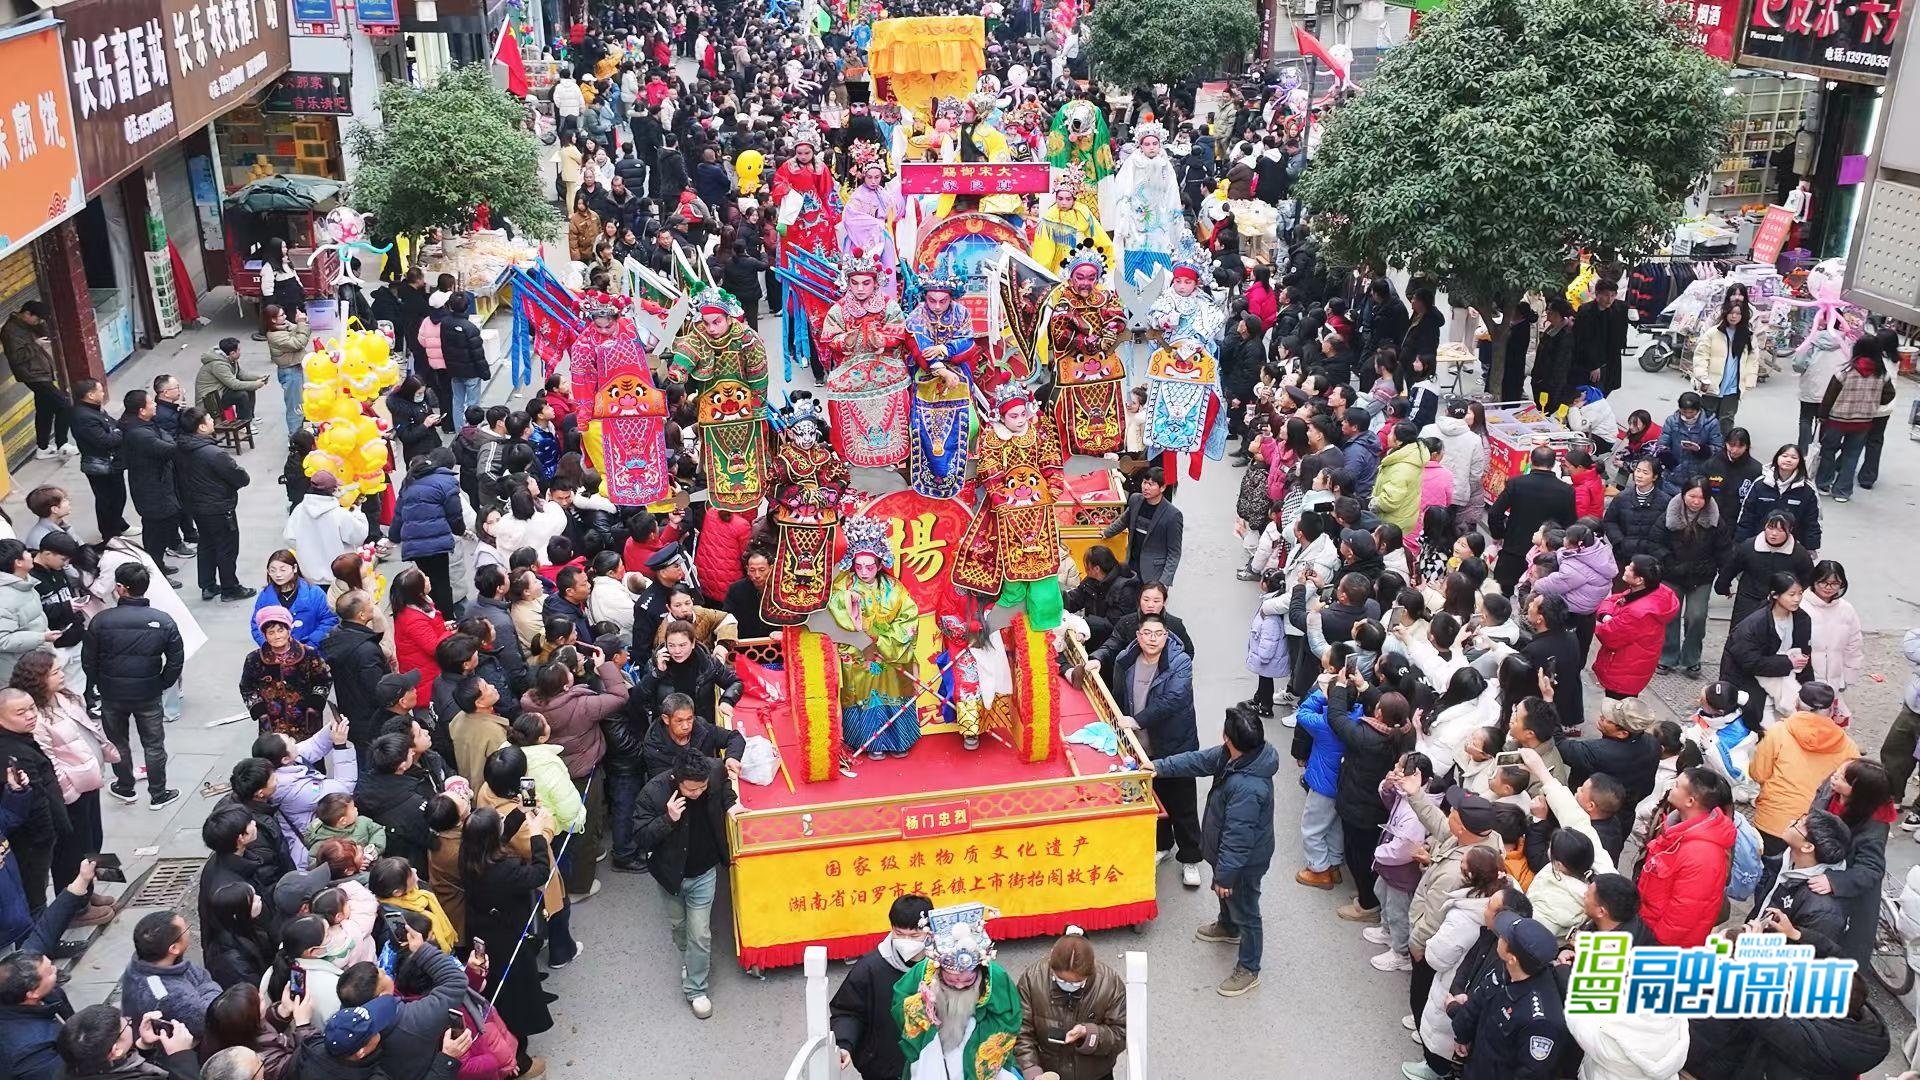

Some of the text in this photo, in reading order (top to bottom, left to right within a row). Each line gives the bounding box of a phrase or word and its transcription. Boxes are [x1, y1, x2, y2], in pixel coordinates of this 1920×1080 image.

[71, 17, 169, 120] 长乐畜医站
[905, 809, 968, 831] 杨门忠烈
[825, 835, 1090, 878] 国家级非物质文化遗产
